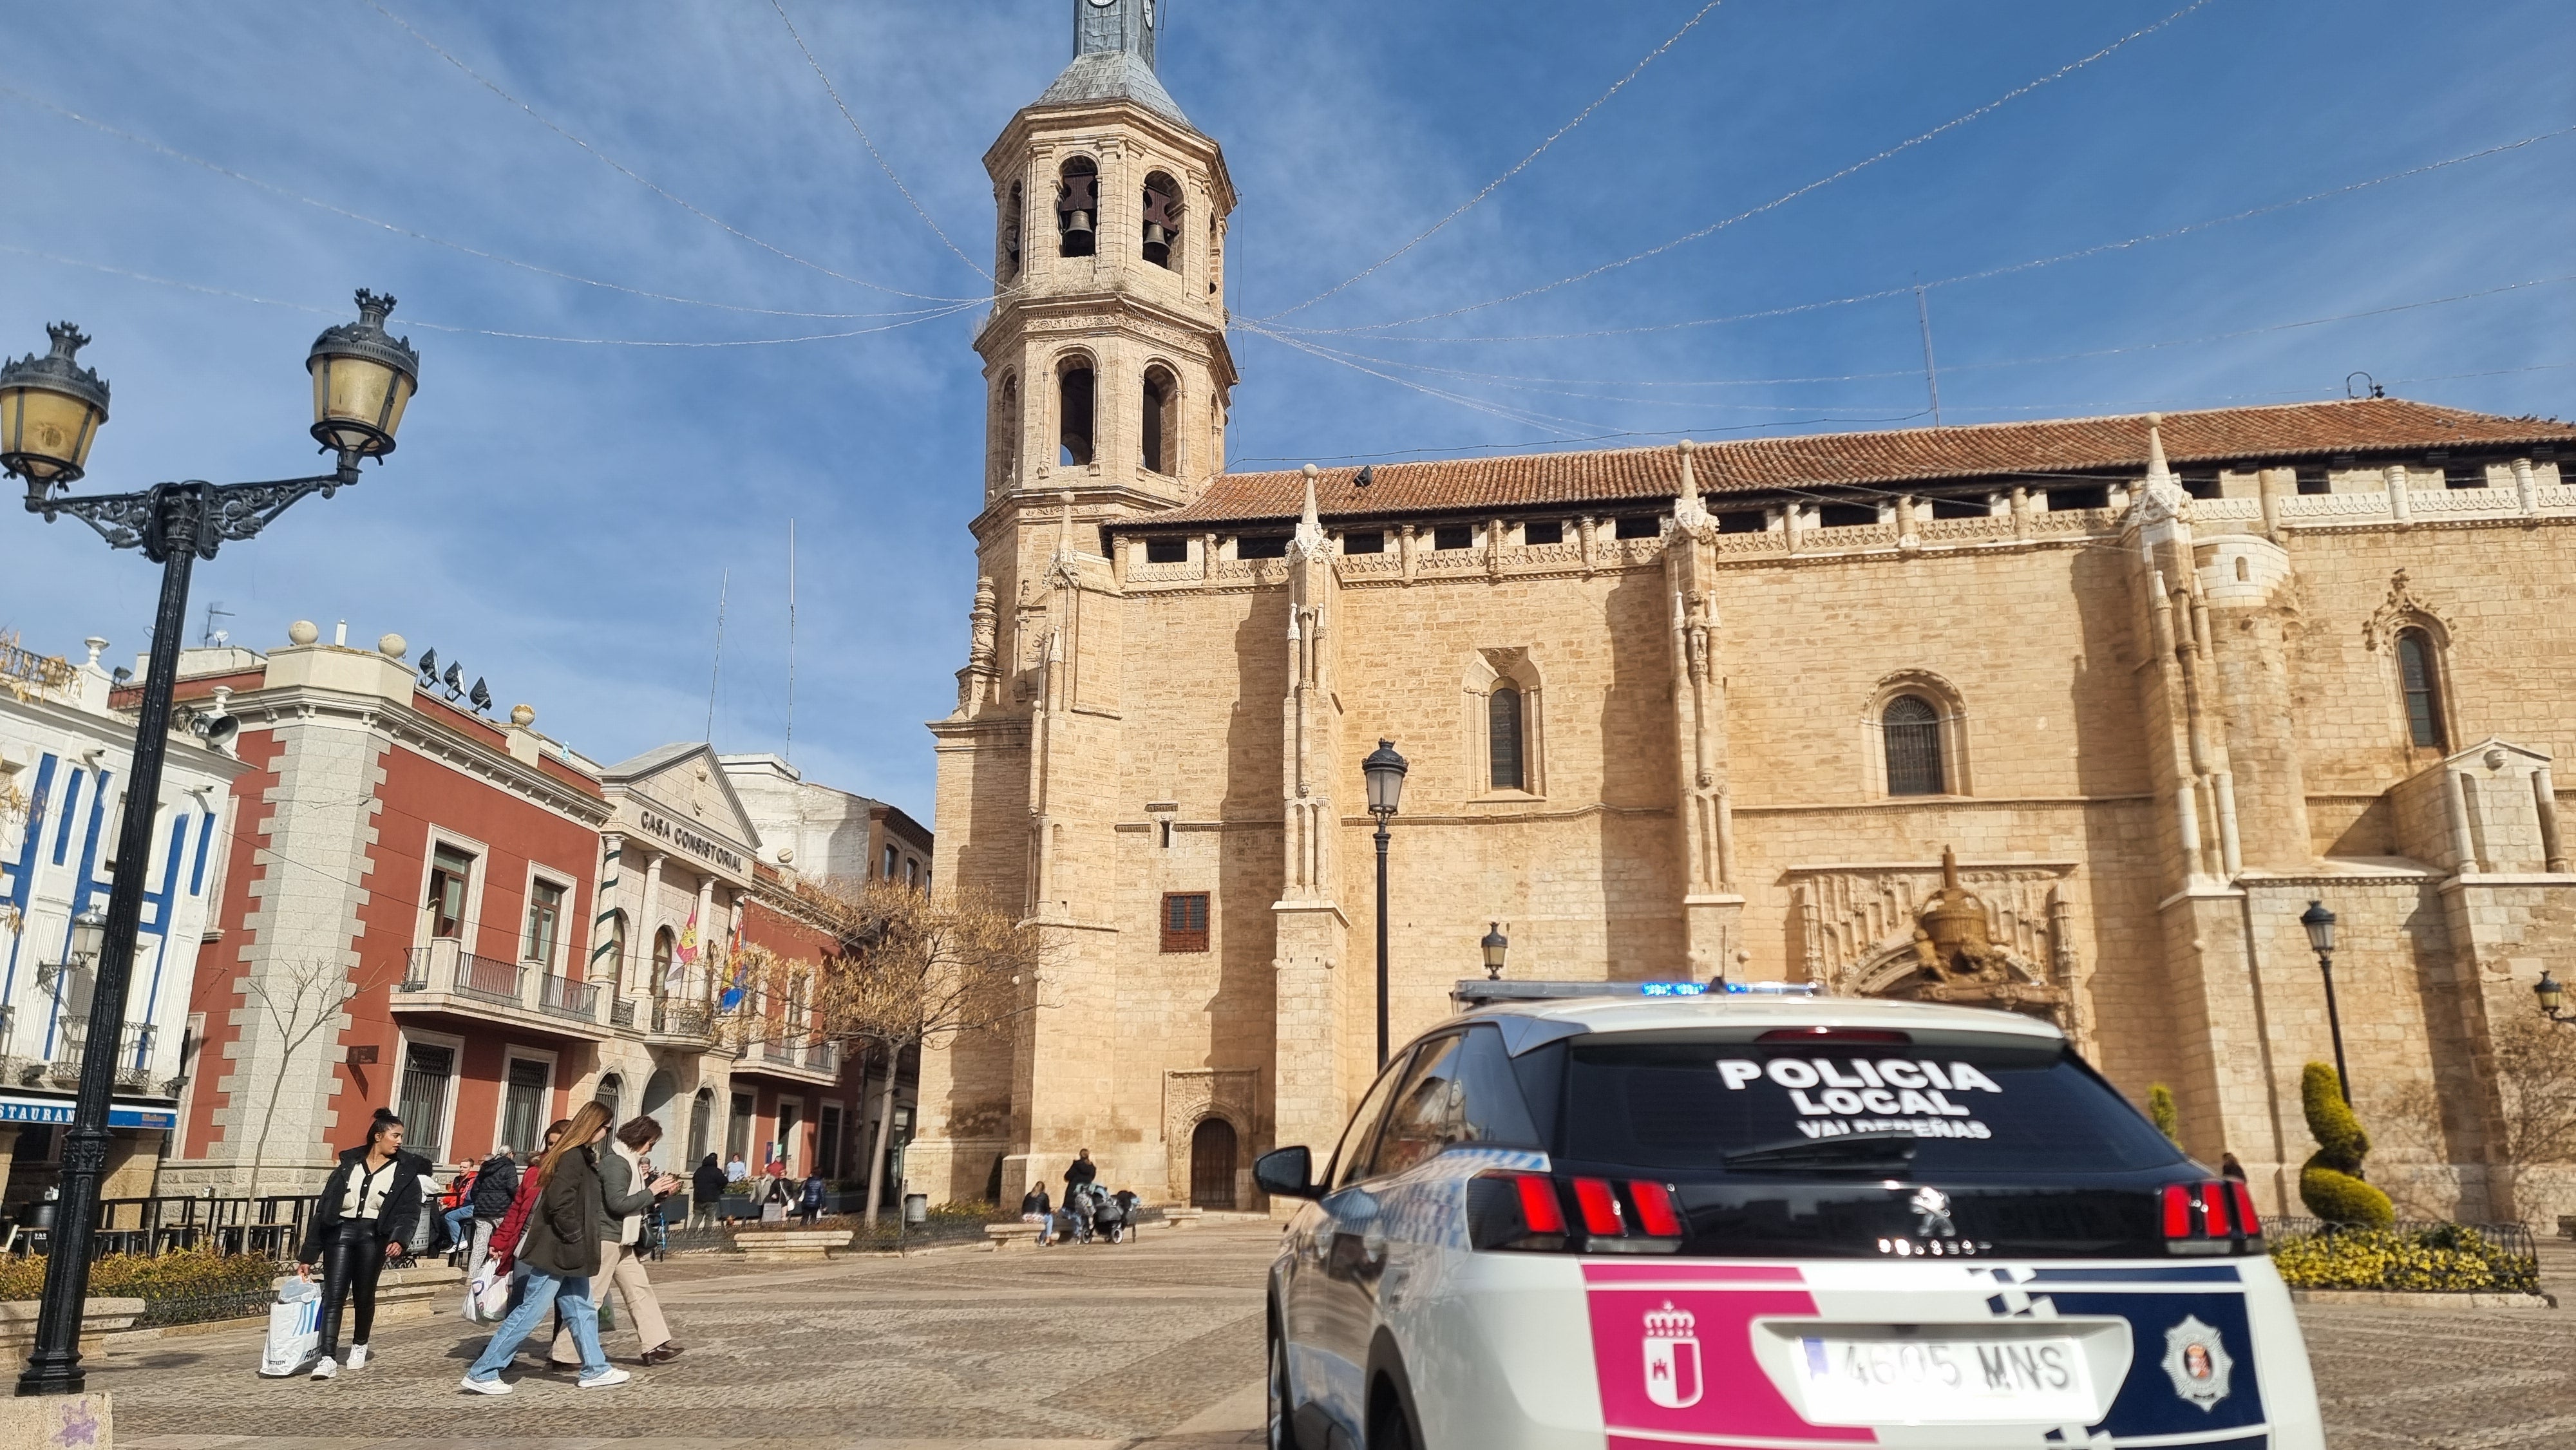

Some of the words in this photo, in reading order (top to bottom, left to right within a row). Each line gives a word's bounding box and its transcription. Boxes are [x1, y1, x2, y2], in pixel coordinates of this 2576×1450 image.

[641, 811, 670, 840] CASA
[674, 827, 742, 873] CONSISTORIAL
[1716, 1058, 2002, 1093] POLICIA
[1789, 1089, 1971, 1116] LOCAL
[1977, 1345, 2069, 1391] MNS
